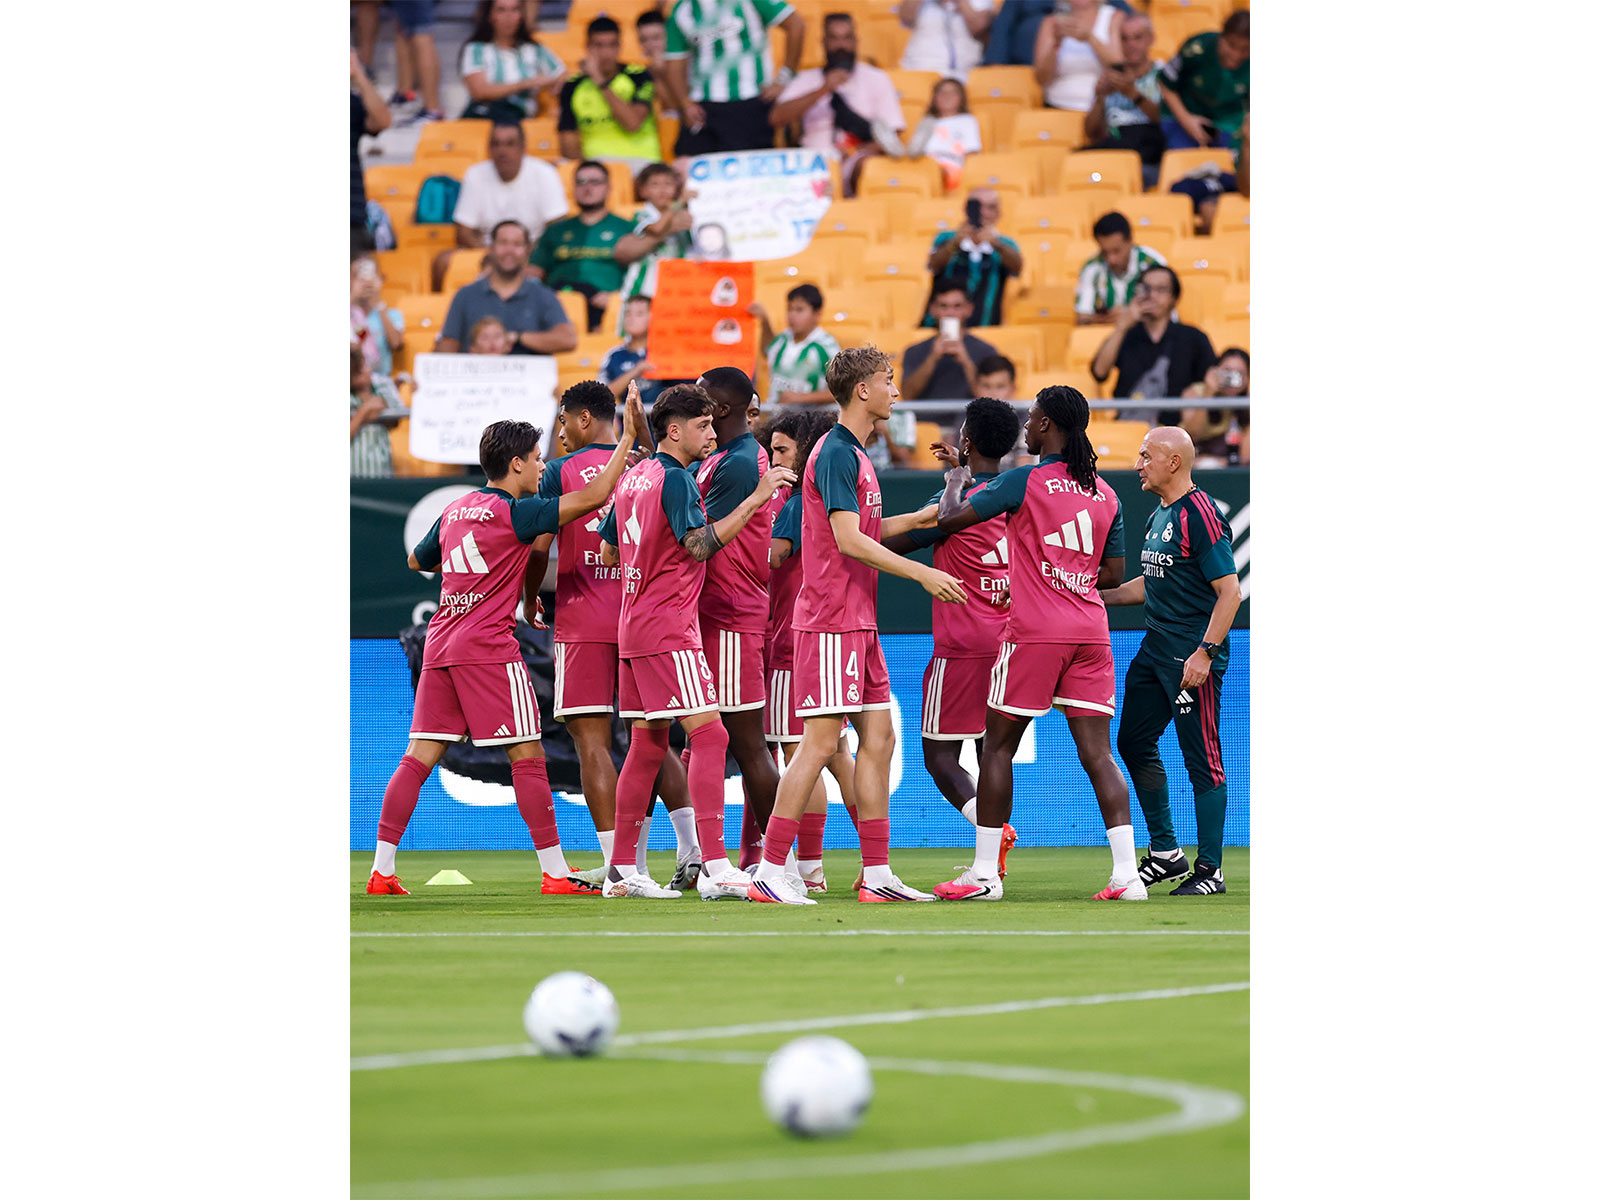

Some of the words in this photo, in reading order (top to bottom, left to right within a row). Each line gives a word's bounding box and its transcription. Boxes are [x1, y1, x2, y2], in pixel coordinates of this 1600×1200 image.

[697, 651, 712, 681] 8
[845, 650, 859, 681] 4
[1180, 706, 1192, 715] AP
